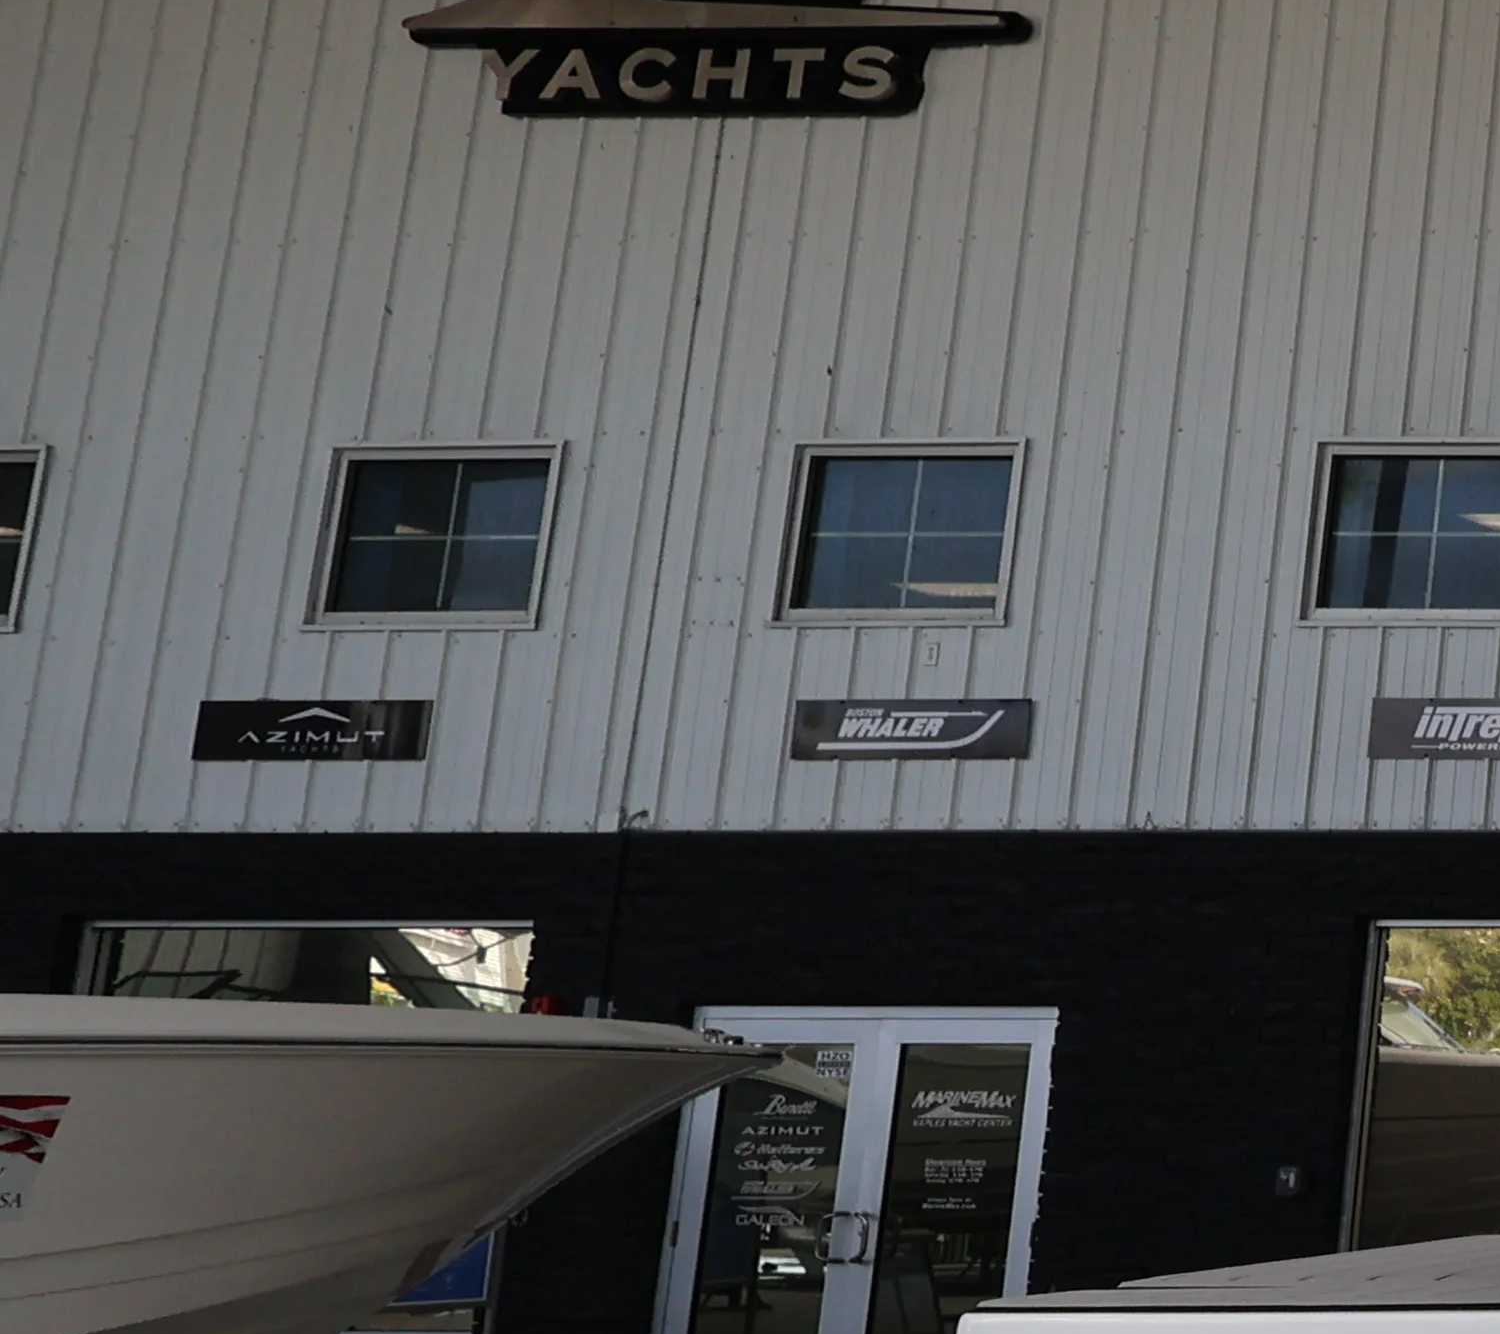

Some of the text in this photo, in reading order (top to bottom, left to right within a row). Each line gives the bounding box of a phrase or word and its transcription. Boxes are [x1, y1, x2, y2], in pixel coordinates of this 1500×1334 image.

[481, 46, 899, 101] YACHTS
[837, 717, 945, 738] WHALER
[236, 730, 385, 744] AZIMUT
[741, 1125, 825, 1136] AZIMUT
